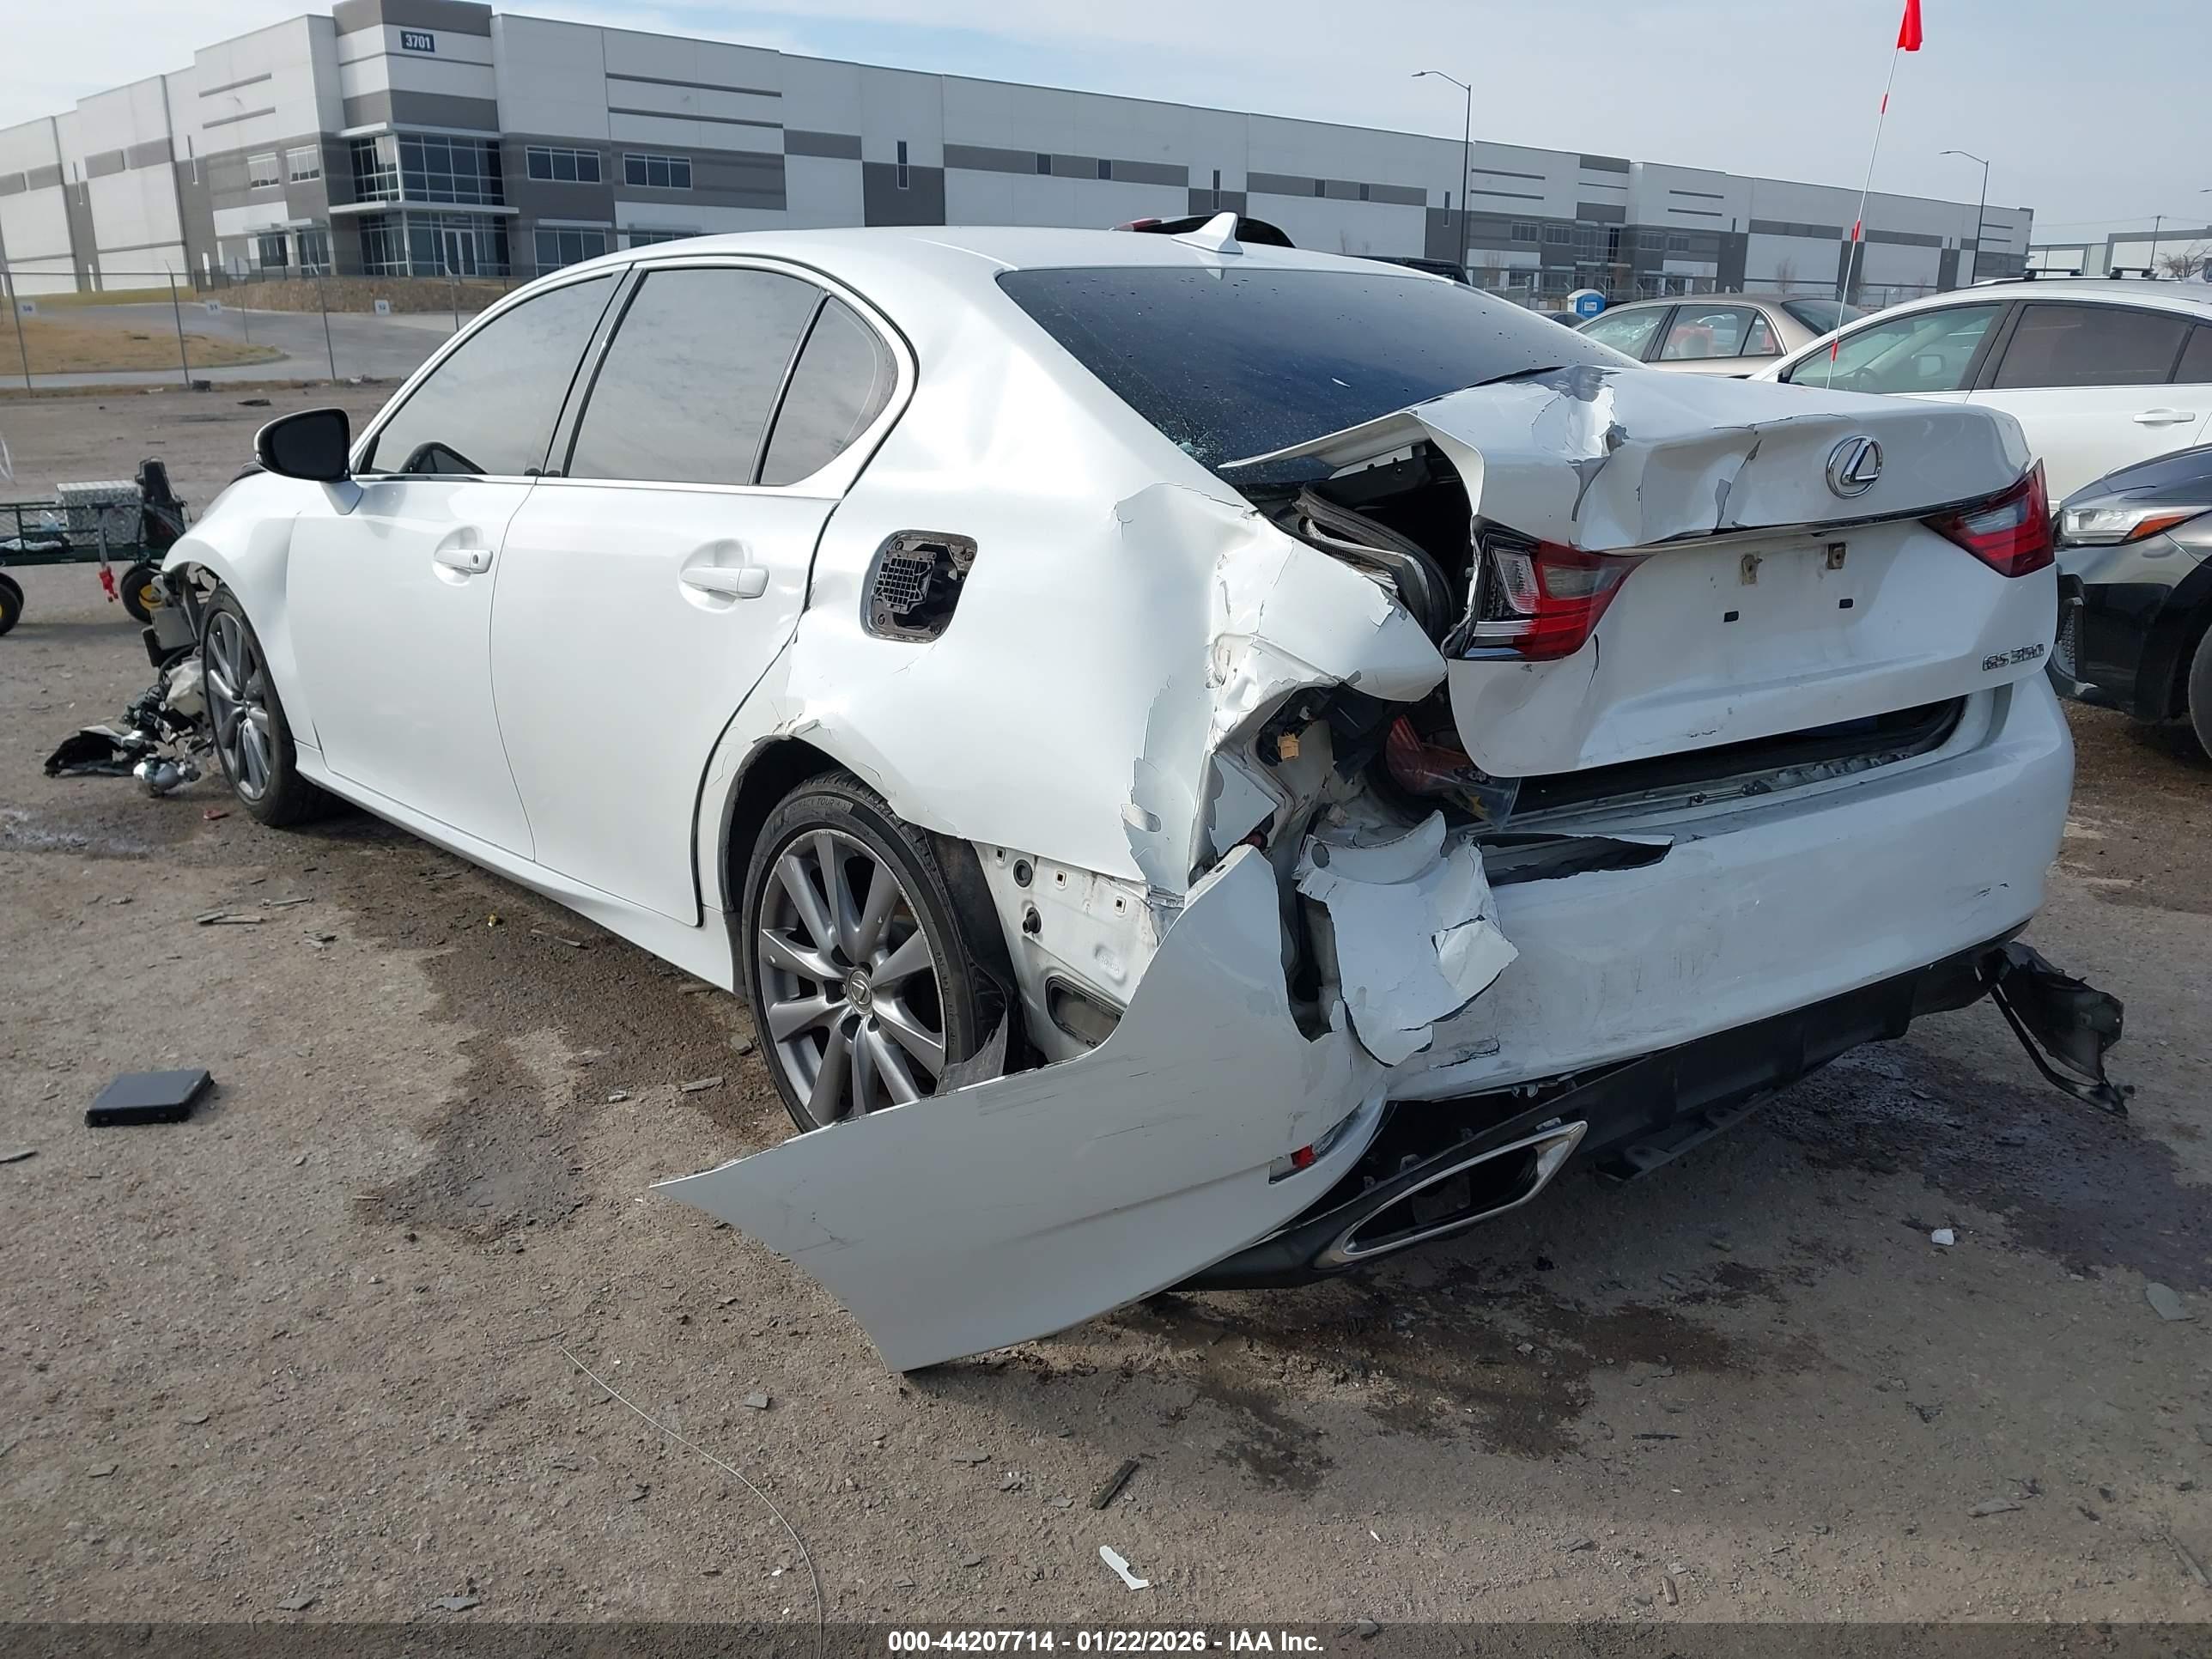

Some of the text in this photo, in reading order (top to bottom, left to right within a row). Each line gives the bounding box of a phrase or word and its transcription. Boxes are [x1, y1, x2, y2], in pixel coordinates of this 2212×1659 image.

[405, 33, 431, 49] 3701
[2010, 643, 2045, 664] 350
[817, 797, 835, 806] TOUR
